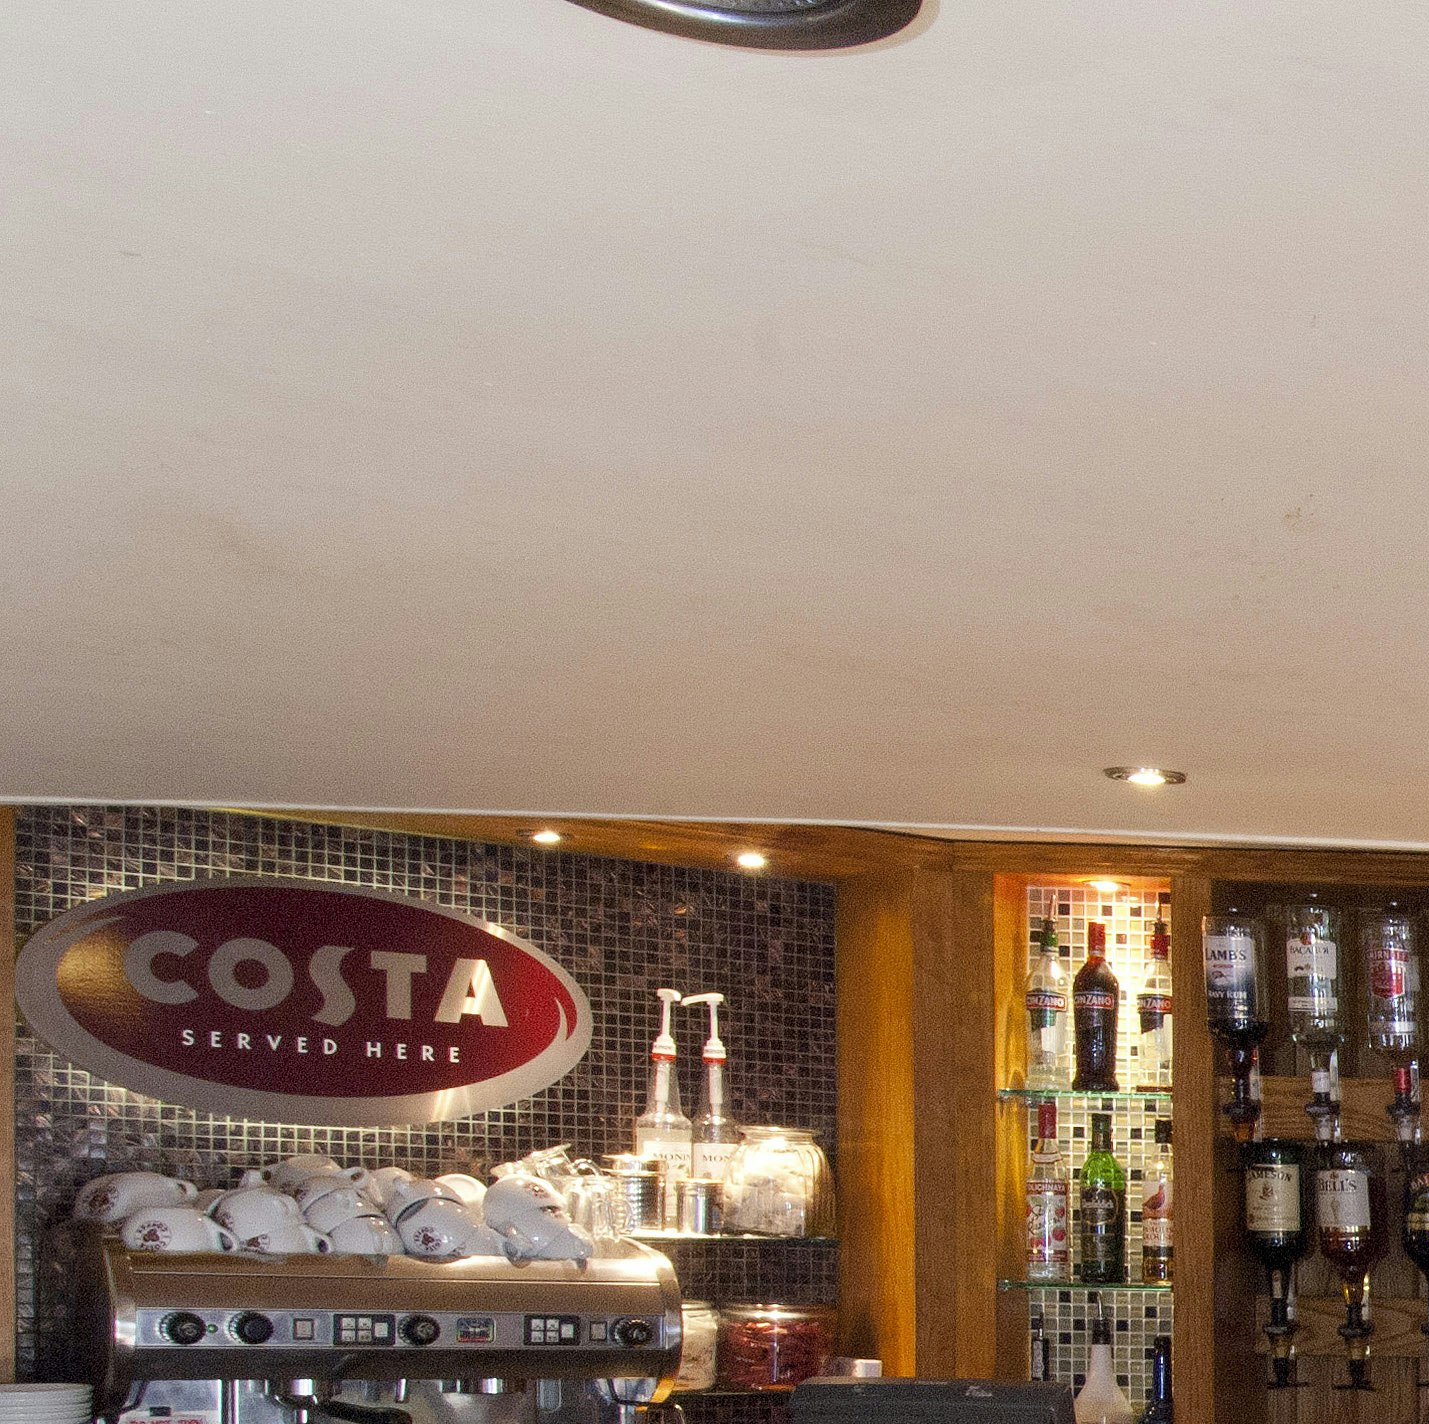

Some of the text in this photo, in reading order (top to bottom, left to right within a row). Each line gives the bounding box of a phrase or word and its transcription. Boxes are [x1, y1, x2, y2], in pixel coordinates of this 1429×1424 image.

[1205, 949, 1247, 962] LAMB'S
[123, 930, 509, 1027] COSTA
[182, 1029, 461, 1063] SERVED HERE
[1319, 1178, 1358, 1191] BELL'S
